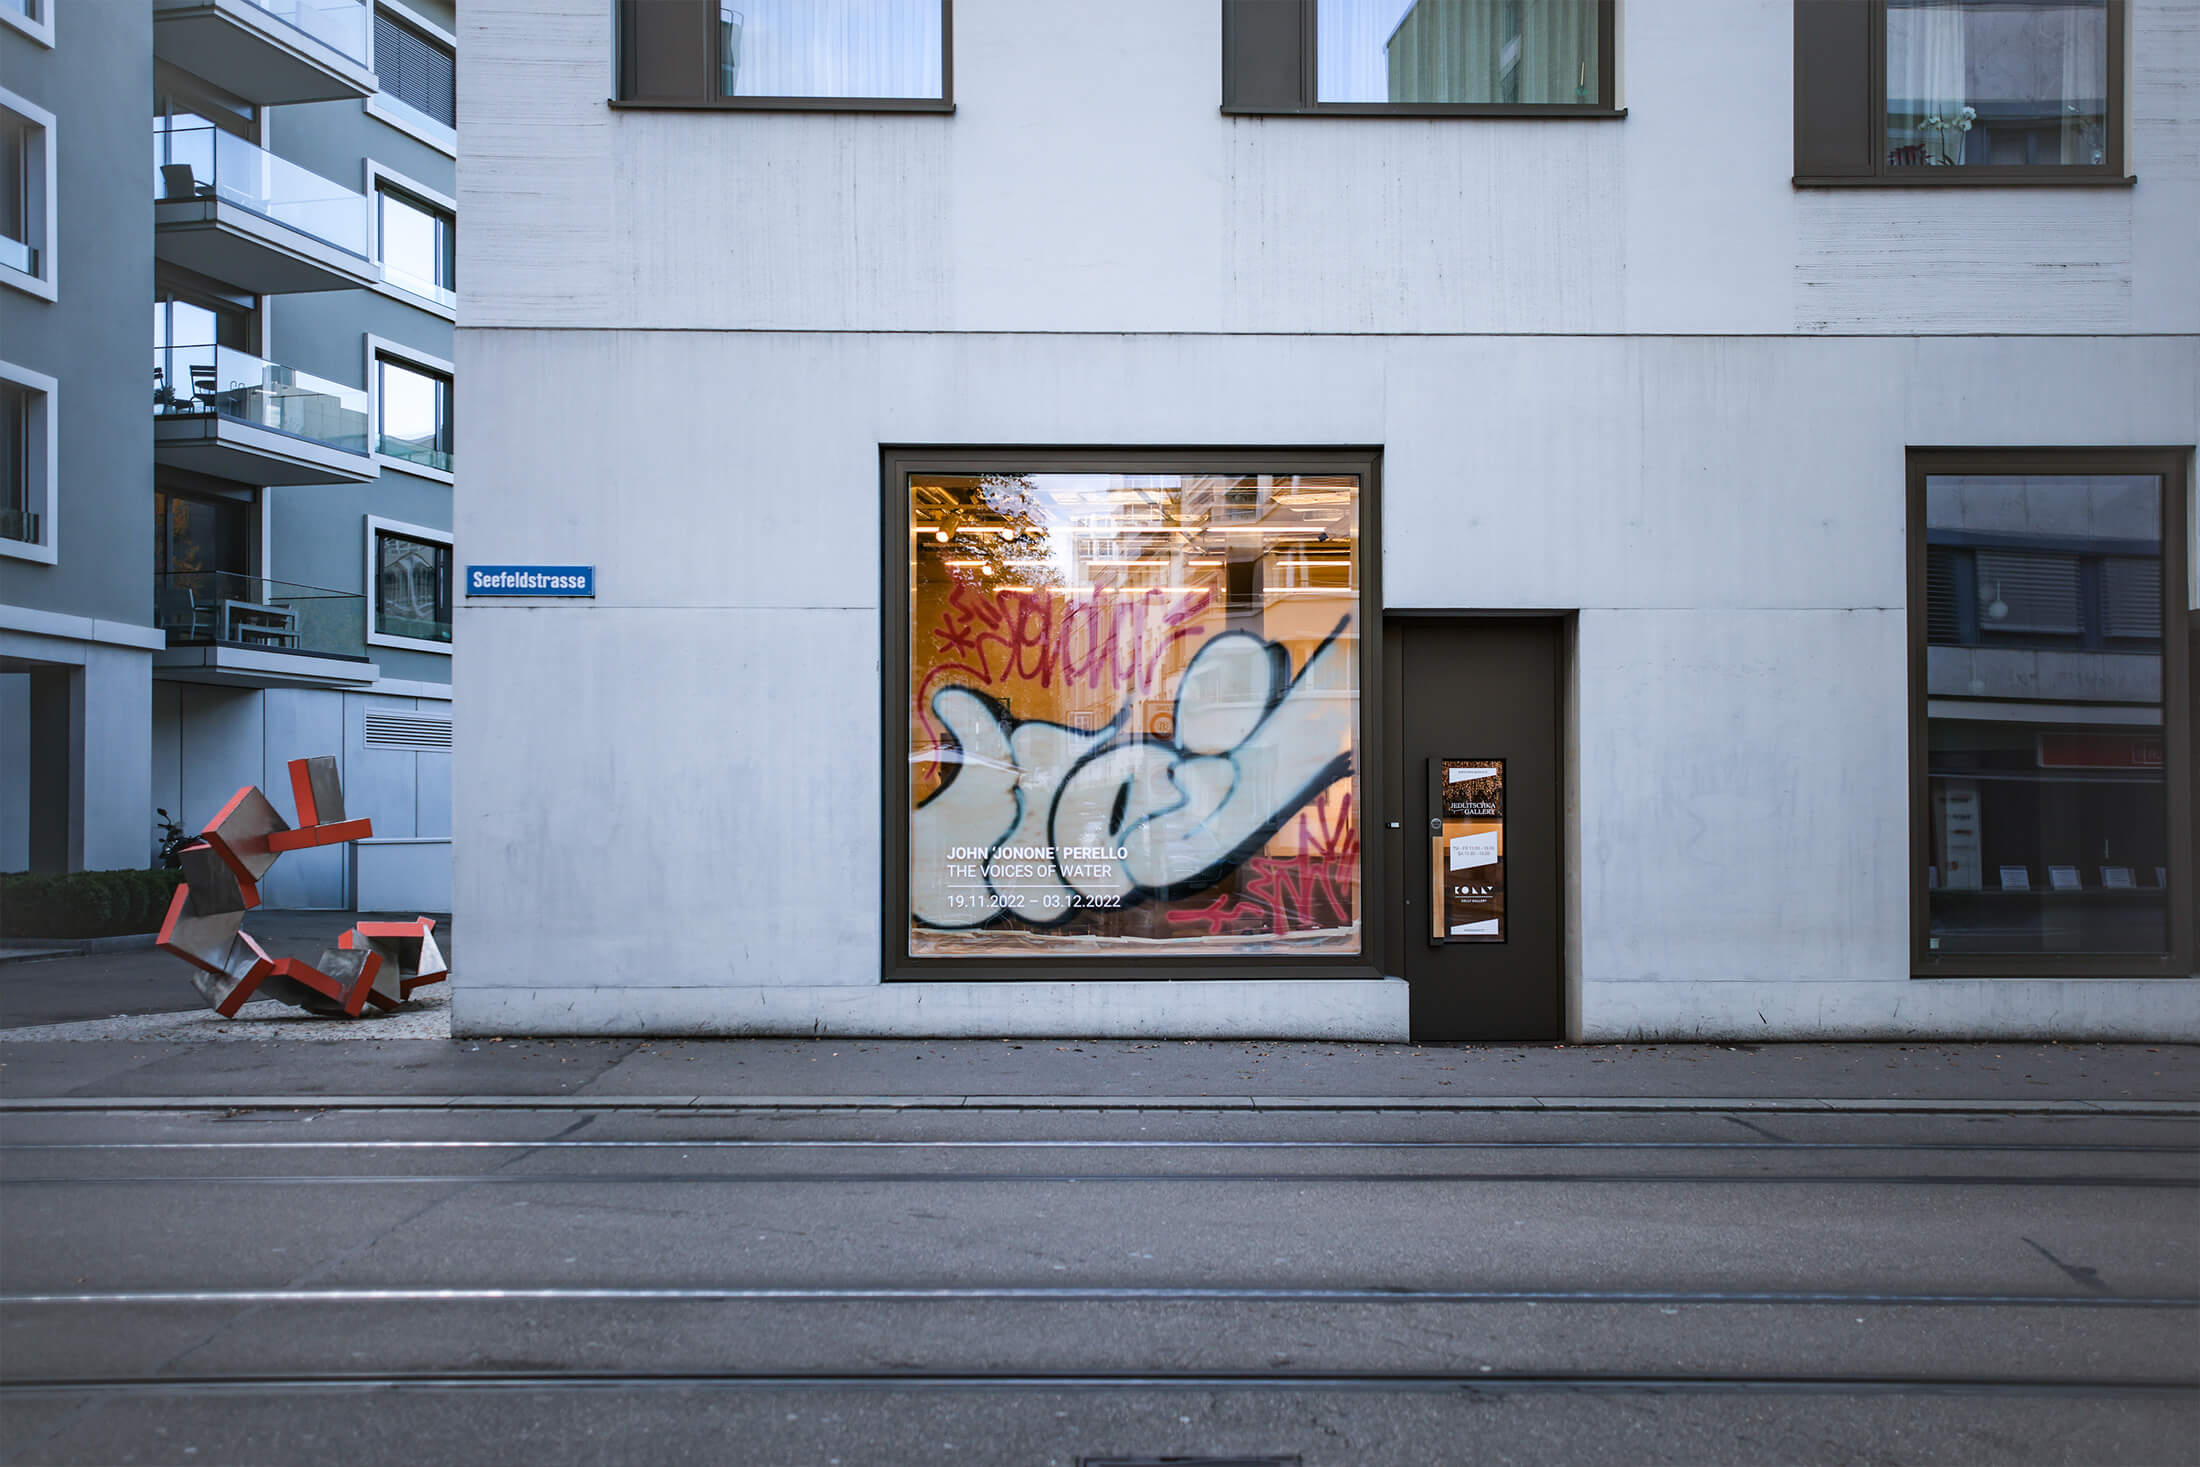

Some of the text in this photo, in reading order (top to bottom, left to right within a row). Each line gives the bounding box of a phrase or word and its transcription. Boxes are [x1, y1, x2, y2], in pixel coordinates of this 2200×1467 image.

[472, 571, 586, 589] Seefeldstrasse
[947, 846, 988, 860] JOHN
[1063, 846, 1128, 860] PERELLO
[947, 864, 1112, 878] THE VOICES OF WATER
[947, 895, 1025, 908] 19.11.2022
[1042, 895, 1121, 908] 03.12.2022
